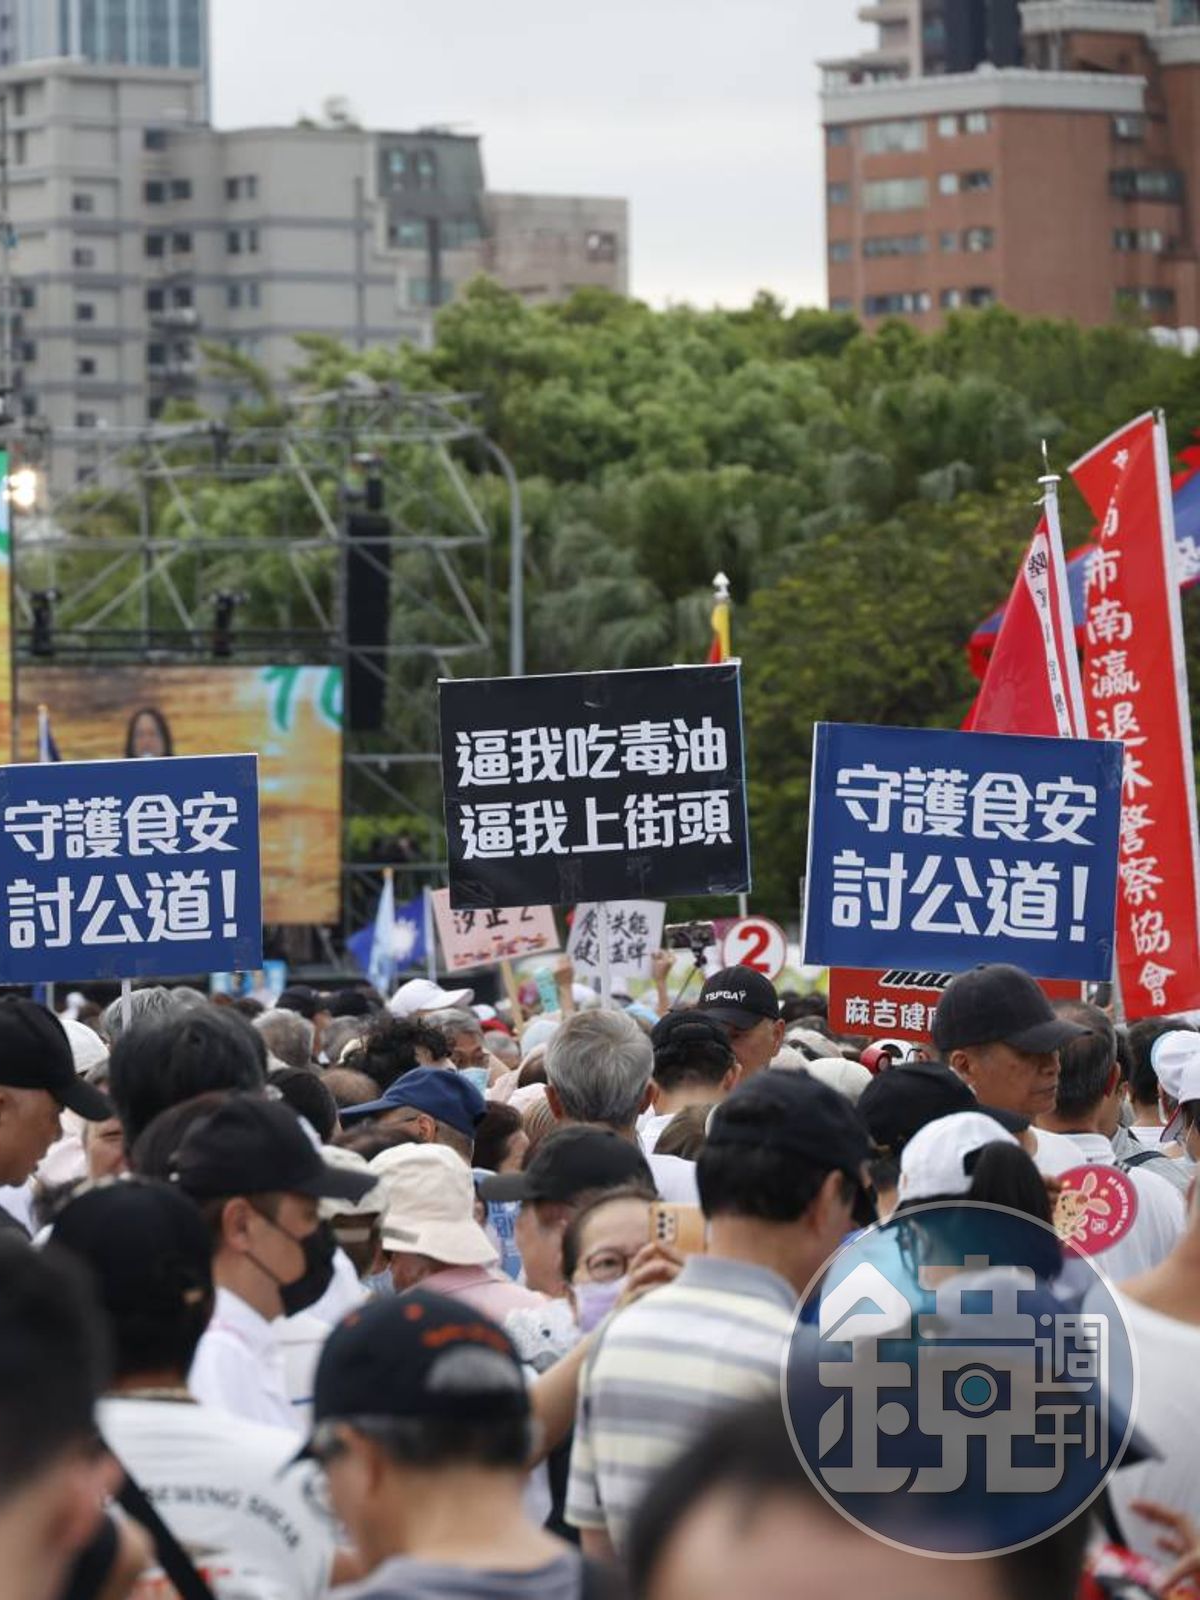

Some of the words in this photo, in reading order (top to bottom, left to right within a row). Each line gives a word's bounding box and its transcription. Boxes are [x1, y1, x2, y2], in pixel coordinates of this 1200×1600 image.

[455, 717, 728, 787] 逼我吃毒油
[4, 791, 240, 861] 守護食安
[459, 789, 733, 860] 逼我上街頭
[836, 763, 1097, 846] 守護食安
[6, 869, 238, 948] 討公道!
[832, 849, 1089, 942] 討公道!
[737, 925, 771, 973] 2
[845, 997, 938, 1031] 麻吉健
